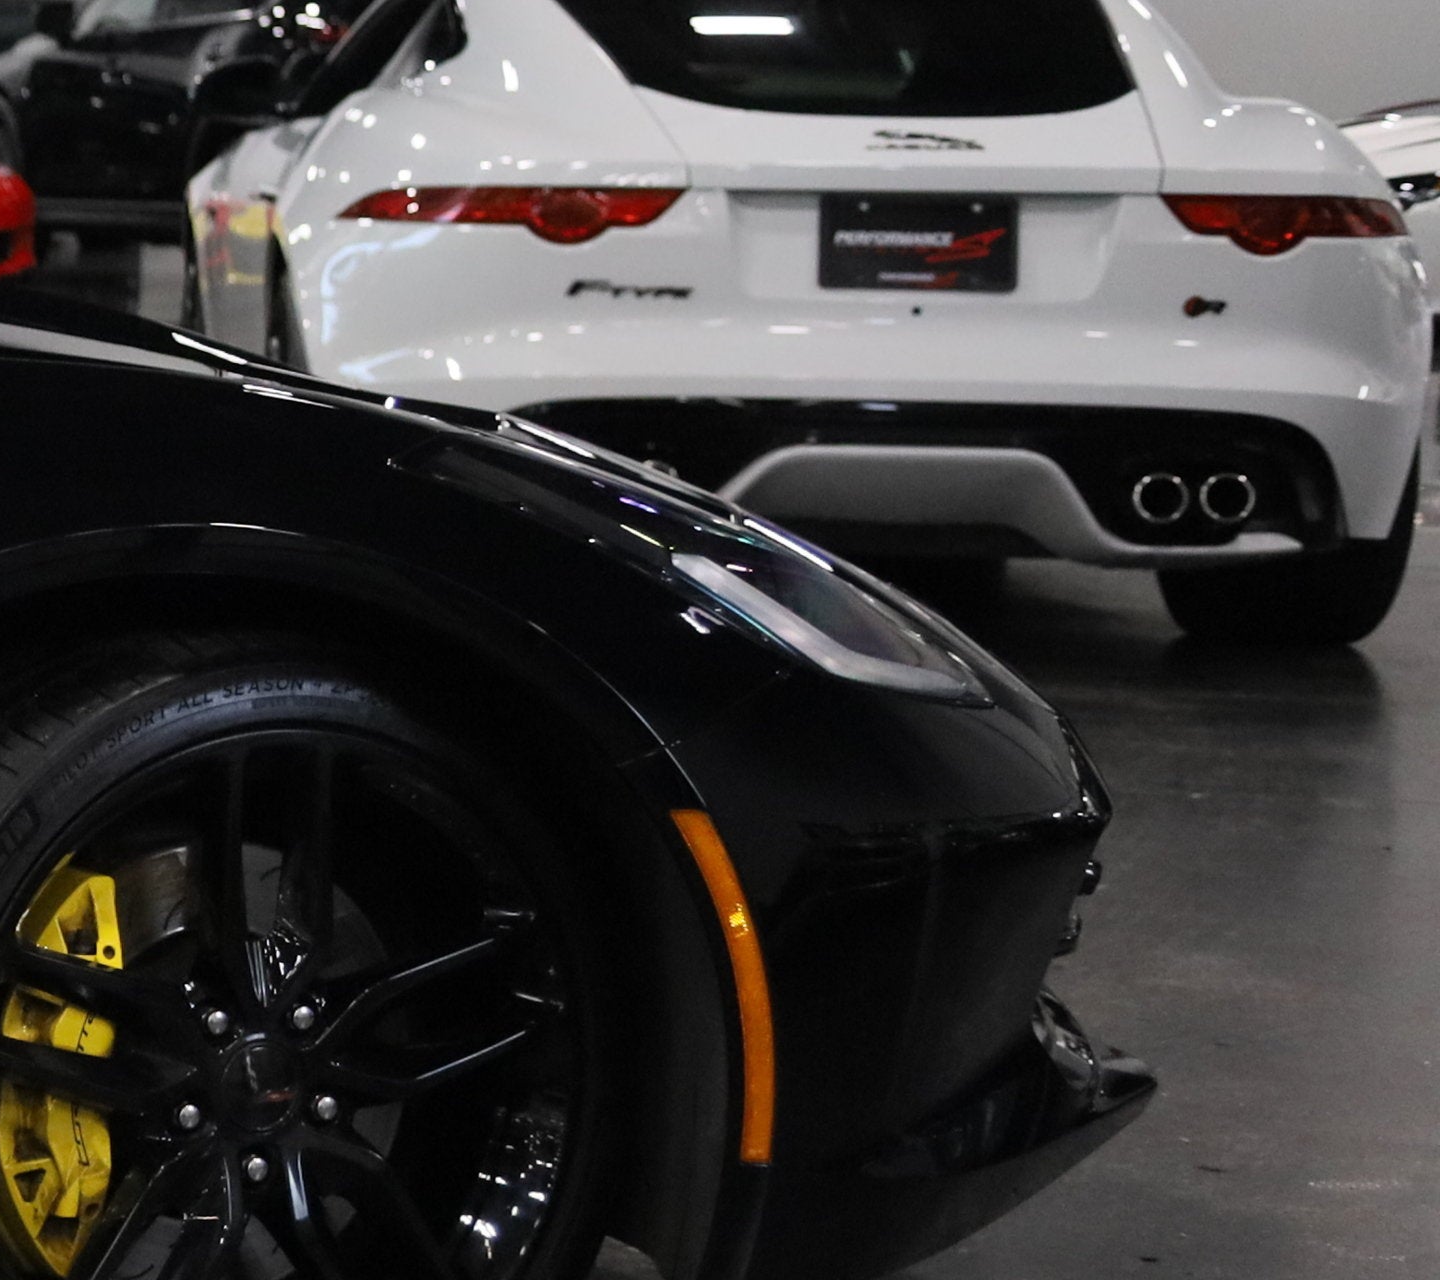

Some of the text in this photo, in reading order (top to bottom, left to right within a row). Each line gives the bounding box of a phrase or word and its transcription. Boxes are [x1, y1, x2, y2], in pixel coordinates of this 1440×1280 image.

[833, 230, 955, 247] PERFORMANCE
[106, 706, 166, 749] SPORT
[177, 692, 213, 714] ALL
[221, 679, 305, 699] SEASON
